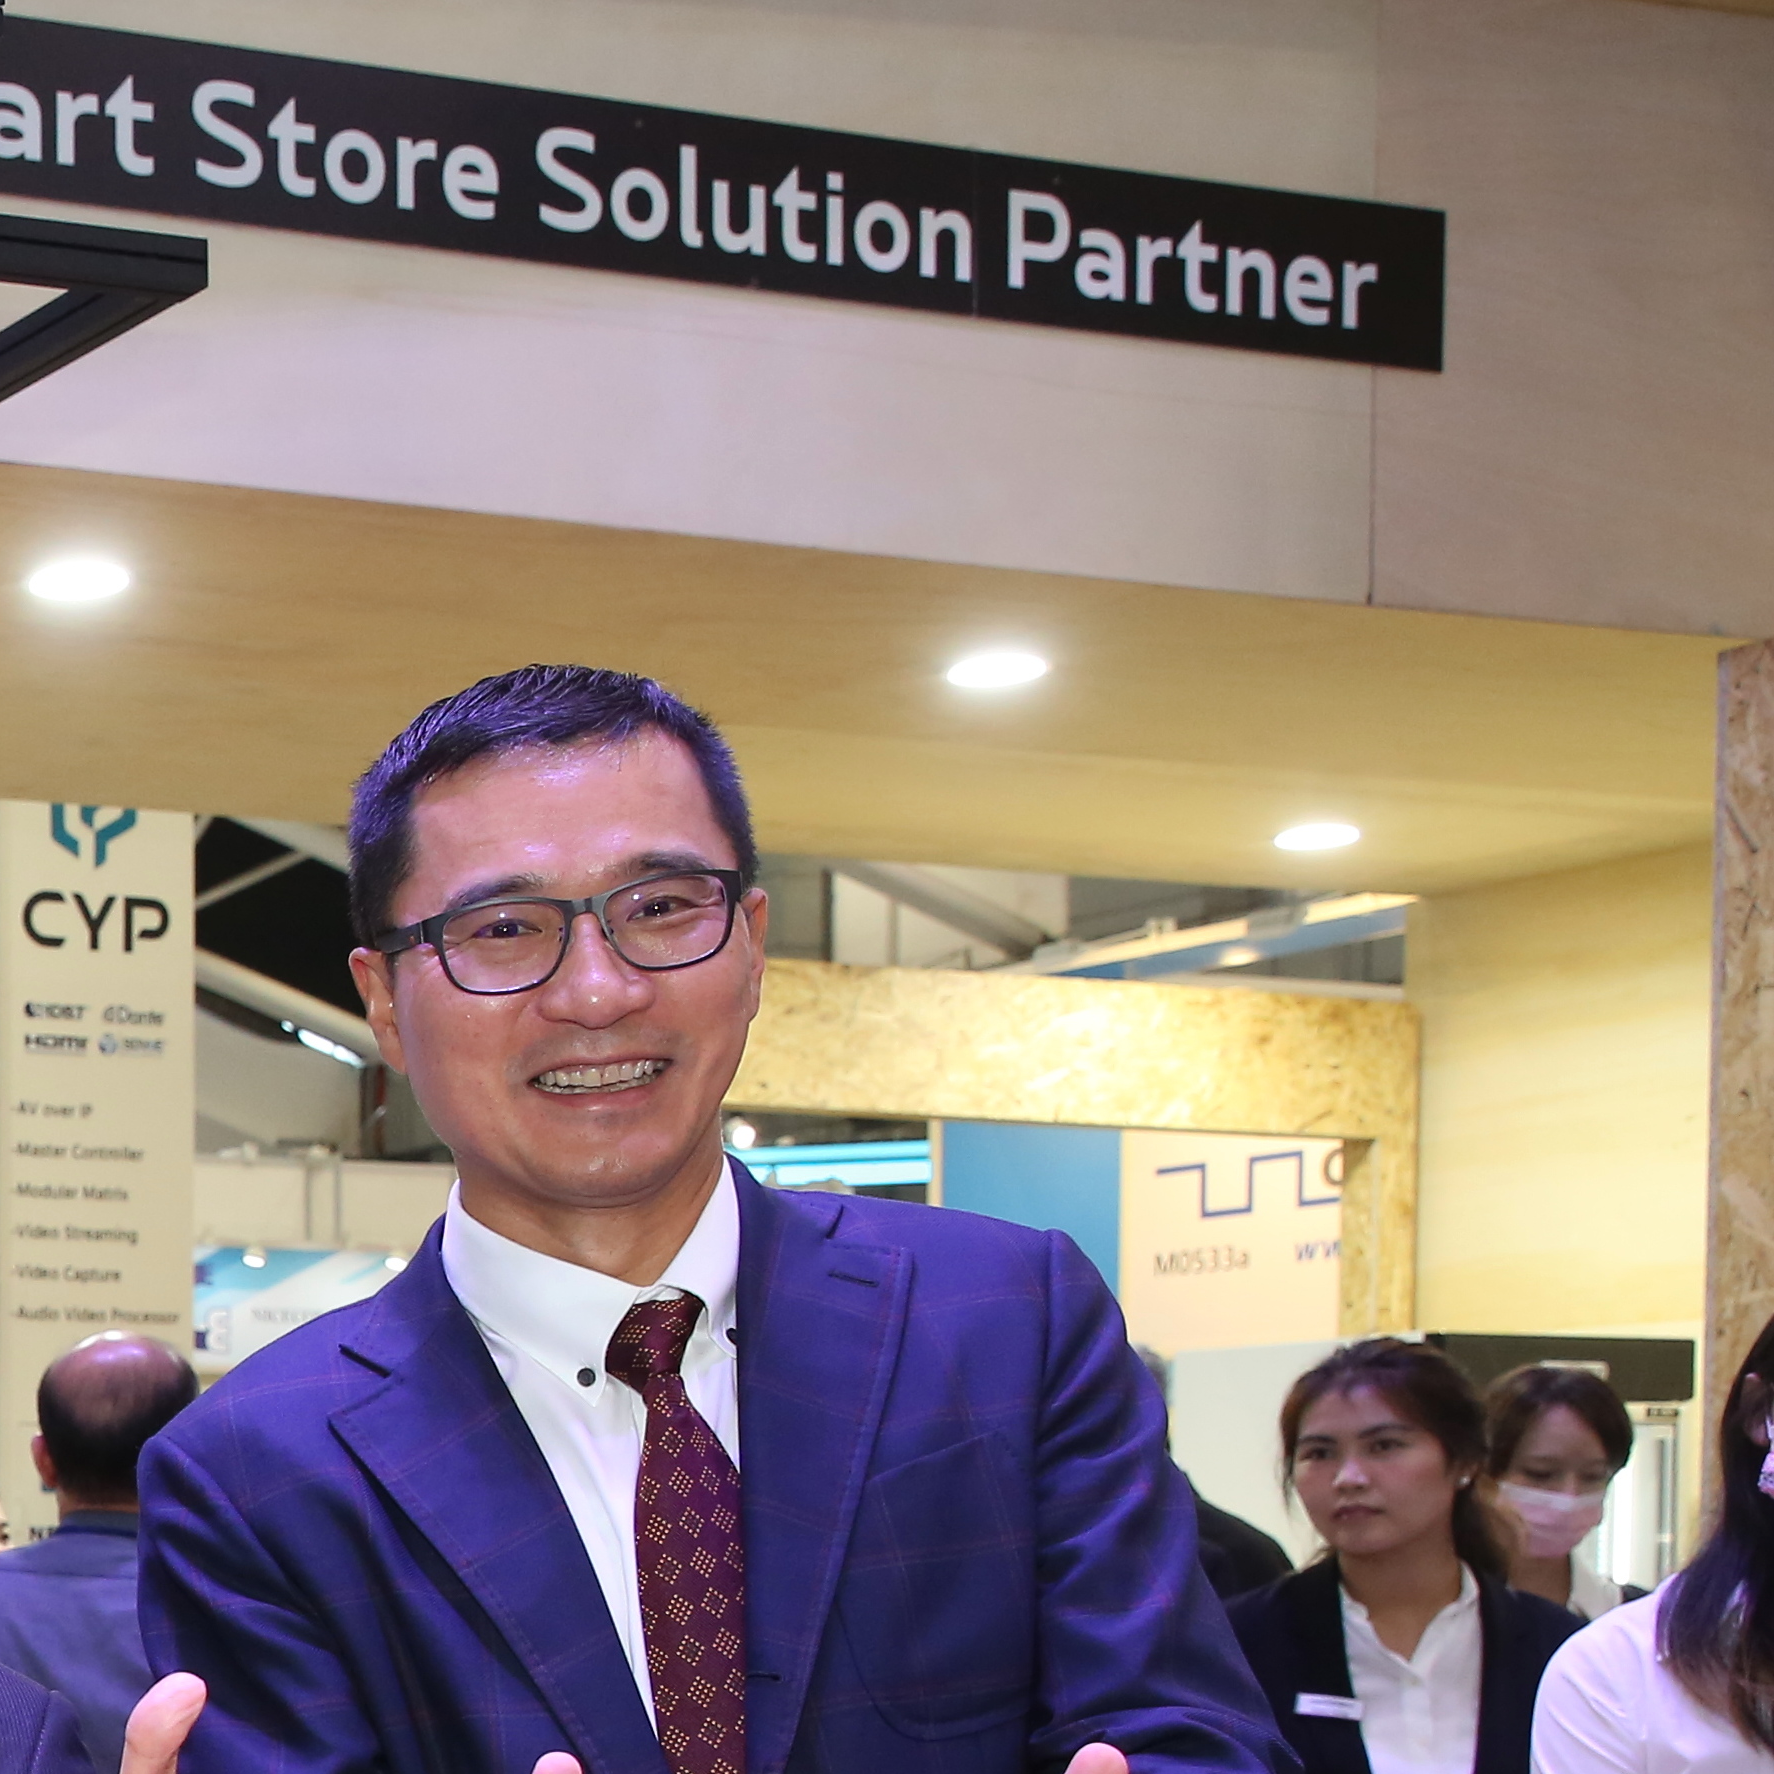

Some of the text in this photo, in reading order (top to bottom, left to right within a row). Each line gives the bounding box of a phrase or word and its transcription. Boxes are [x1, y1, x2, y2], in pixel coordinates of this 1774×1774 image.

[193, 78, 500, 220] Store
[535, 127, 973, 283] Solution
[1008, 189, 1378, 329] Partner
[22, 891, 170, 952] CYP
[82, 1186, 129, 1201] Matrix
[64, 1226, 139, 1245] Streaming
[63, 1265, 121, 1282] Capture
[63, 1306, 180, 1323] Video Processor
